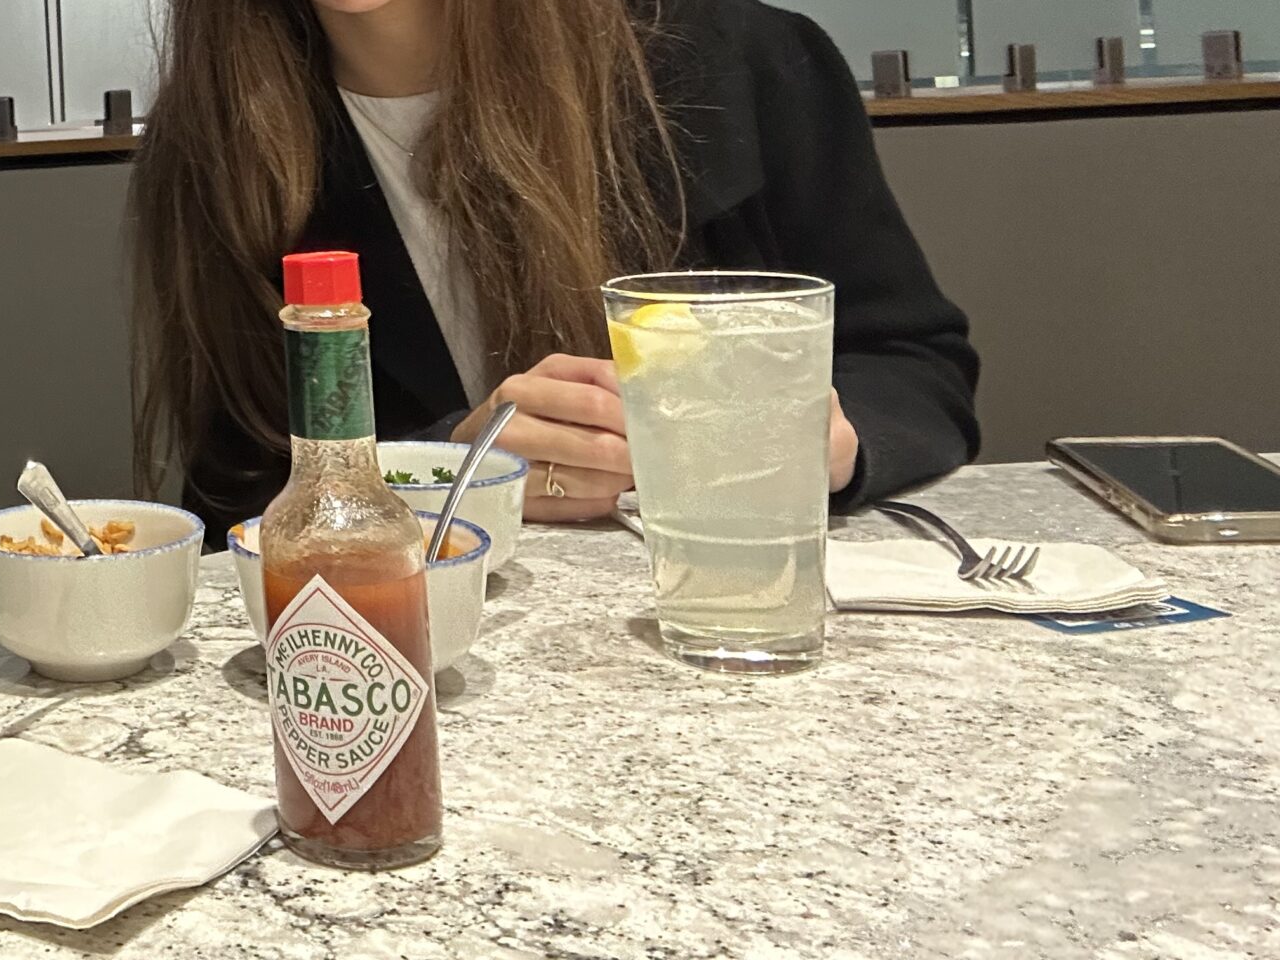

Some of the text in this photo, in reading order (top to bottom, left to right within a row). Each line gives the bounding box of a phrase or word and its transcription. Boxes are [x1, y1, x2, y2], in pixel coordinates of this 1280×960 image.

[297, 654, 351, 674] AVERY ISLAND
[298, 711, 354, 733] BRAND
[279, 704, 389, 769] PEPPER SAUCE
